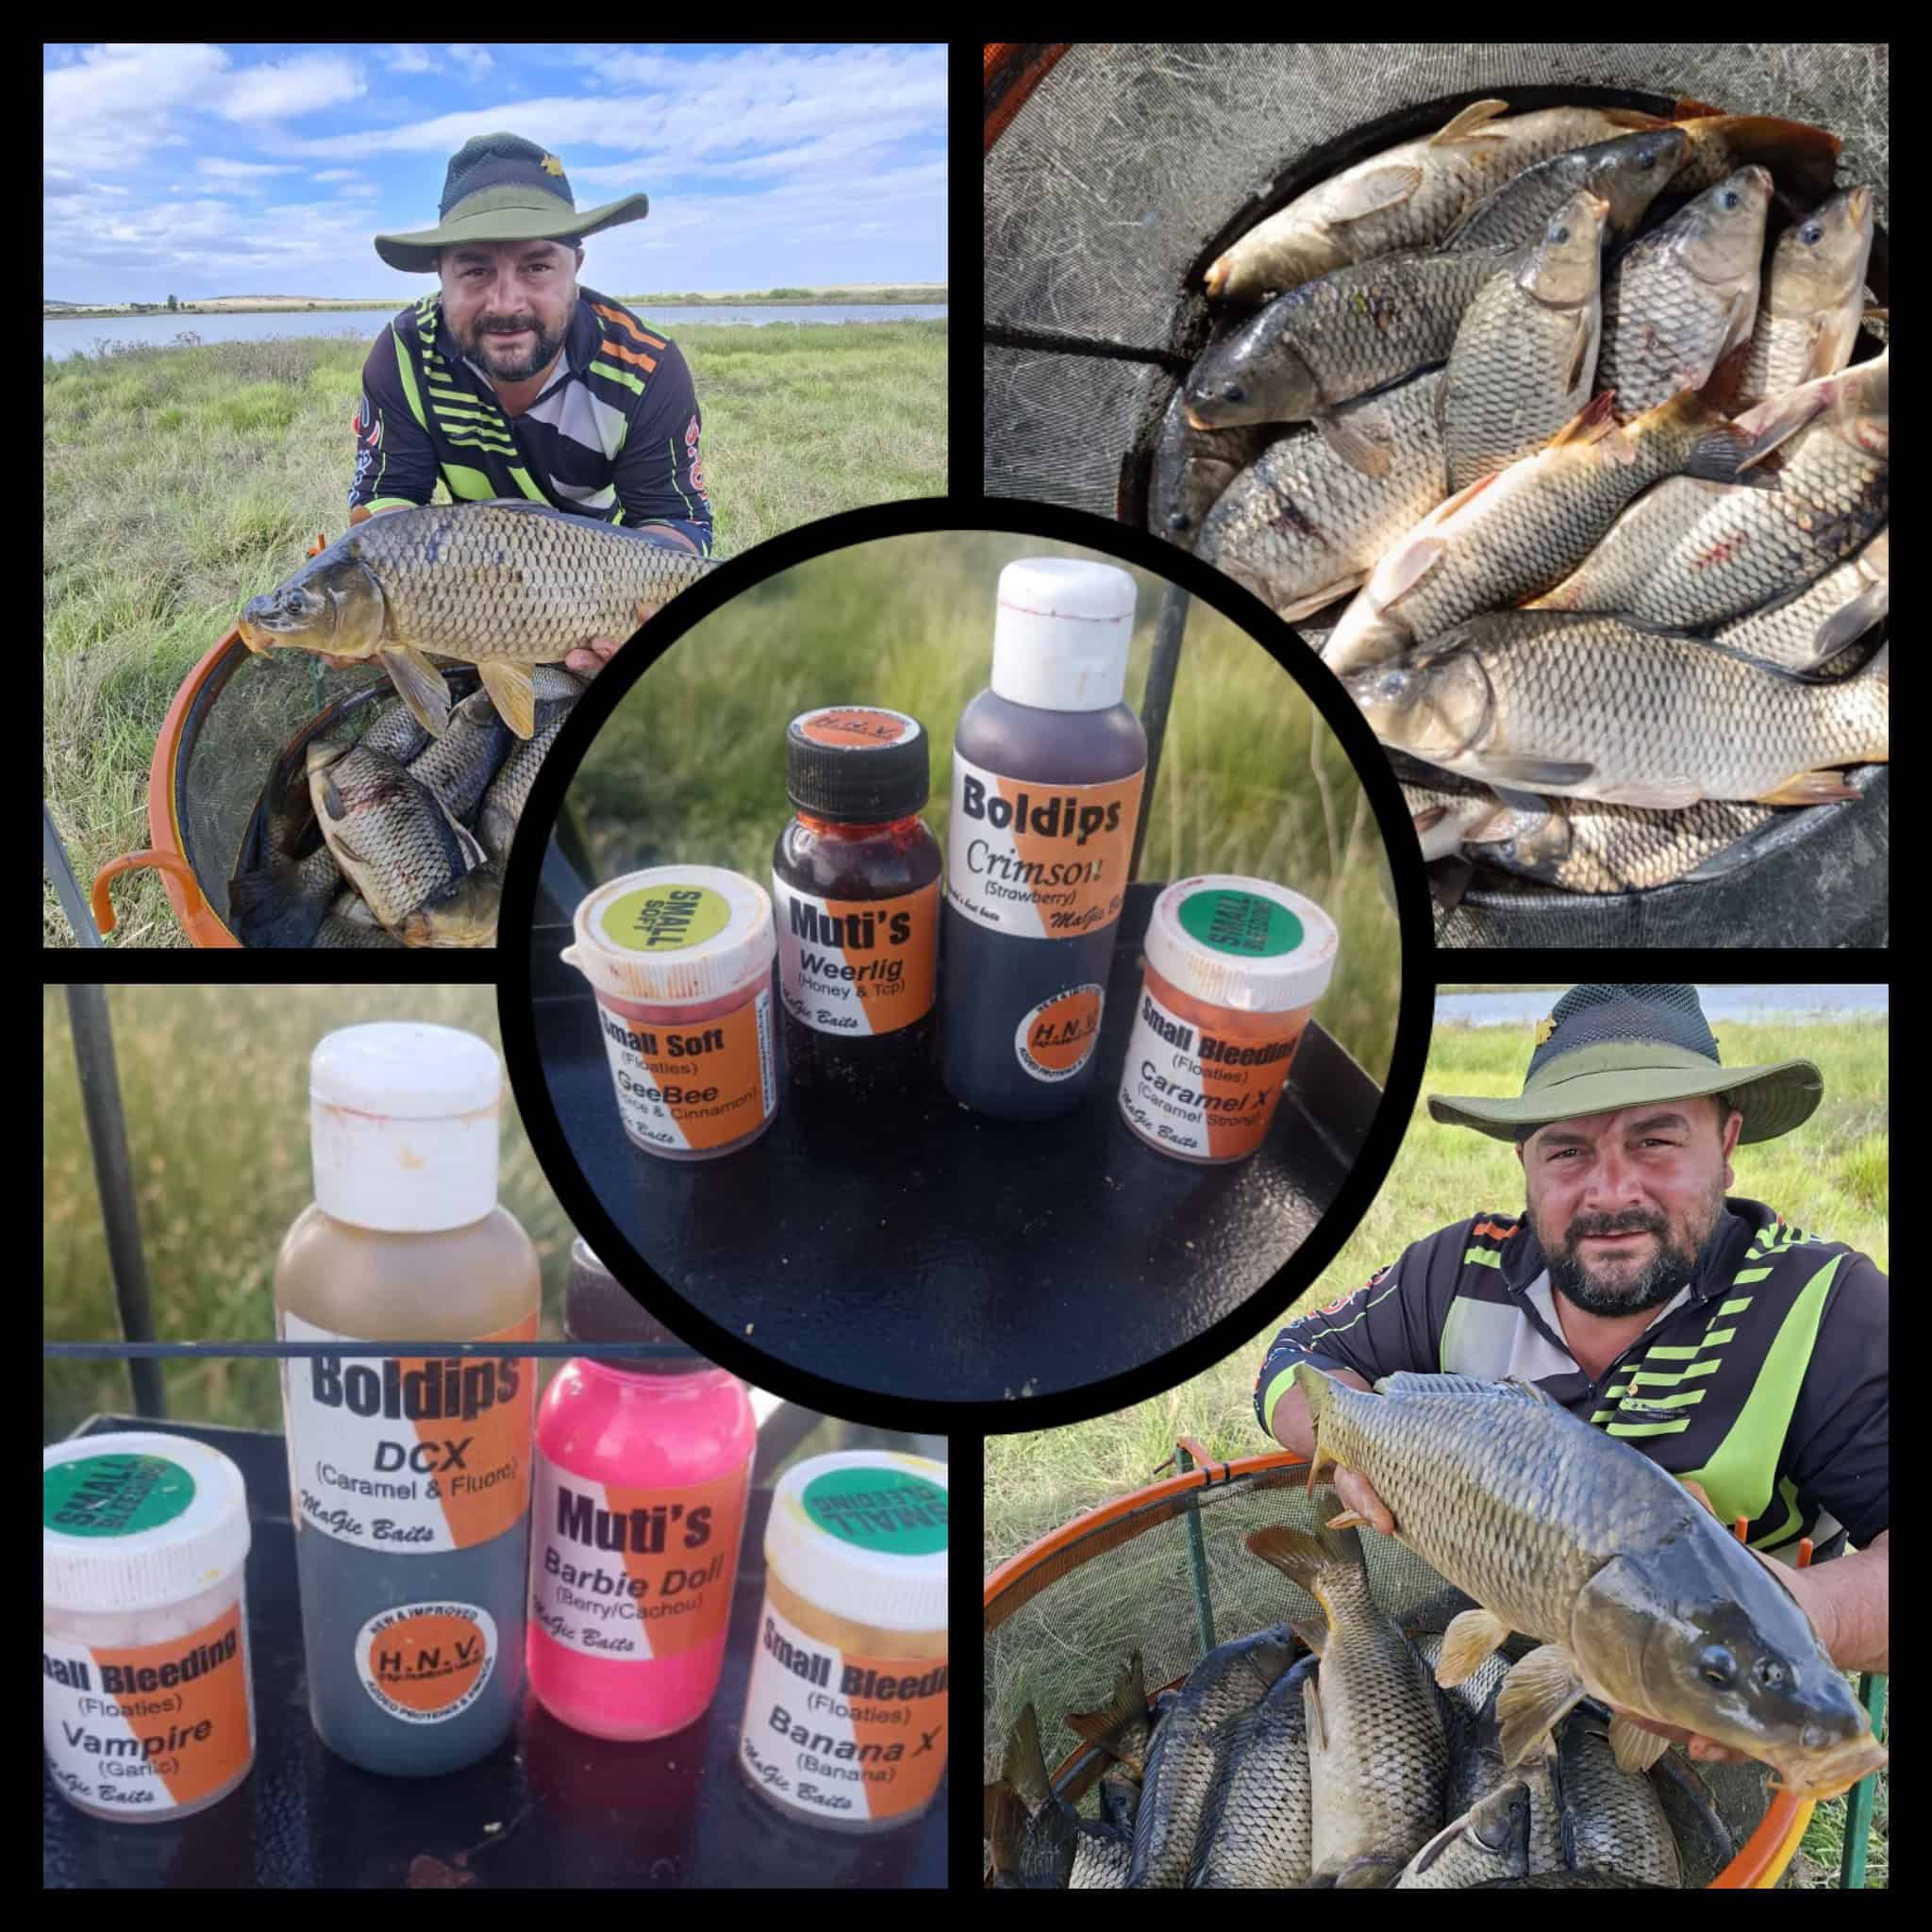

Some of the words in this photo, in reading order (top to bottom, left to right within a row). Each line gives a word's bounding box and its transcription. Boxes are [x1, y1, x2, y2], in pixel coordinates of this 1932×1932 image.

[963, 774, 1122, 845] Boldips
[985, 880, 1077, 907] (Strawberry)
[645, 890, 702, 946] SMALL
[791, 895, 911, 950] Muti's
[799, 948, 904, 982] Weerlig
[797, 972, 851, 1001] (Honey
[816, 1008, 858, 1028] Baits
[1141, 995, 1194, 1053] Small
[666, 1028, 725, 1057] Soft
[617, 1070, 720, 1105] GeeBee
[1137, 1082, 1203, 1124] (Caramel
[1141, 1059, 1251, 1111] Caramel
[1253, 1088, 1272, 1109] X
[1157, 1124, 1199, 1148] Baits
[310, 1355, 520, 1422] Boldips
[374, 1436, 475, 1474] DCX
[316, 1459, 418, 1501] (Caramel
[425, 1481, 441, 1500] &
[300, 1489, 363, 1536] MaGic
[371, 1518, 435, 1542] Baits
[558, 1486, 712, 1554] Muti's
[543, 1544, 649, 1599] Barbie
[659, 1551, 725, 1596] Doll
[581, 1627, 636, 1652] Baits
[763, 1616, 832, 1688] Small
[77, 1693, 183, 1718] (Floaties)
[807, 1691, 911, 1724] (Floaties)
[62, 1719, 213, 1761] Vampire
[768, 1704, 906, 1764] Banana
[911, 1725, 941, 1758] X
[97, 1756, 180, 1779] (Garlic)
[796, 1752, 897, 1784] (Banana)
[97, 1784, 155, 1804] Baits
[796, 1782, 852, 1810] Baits
